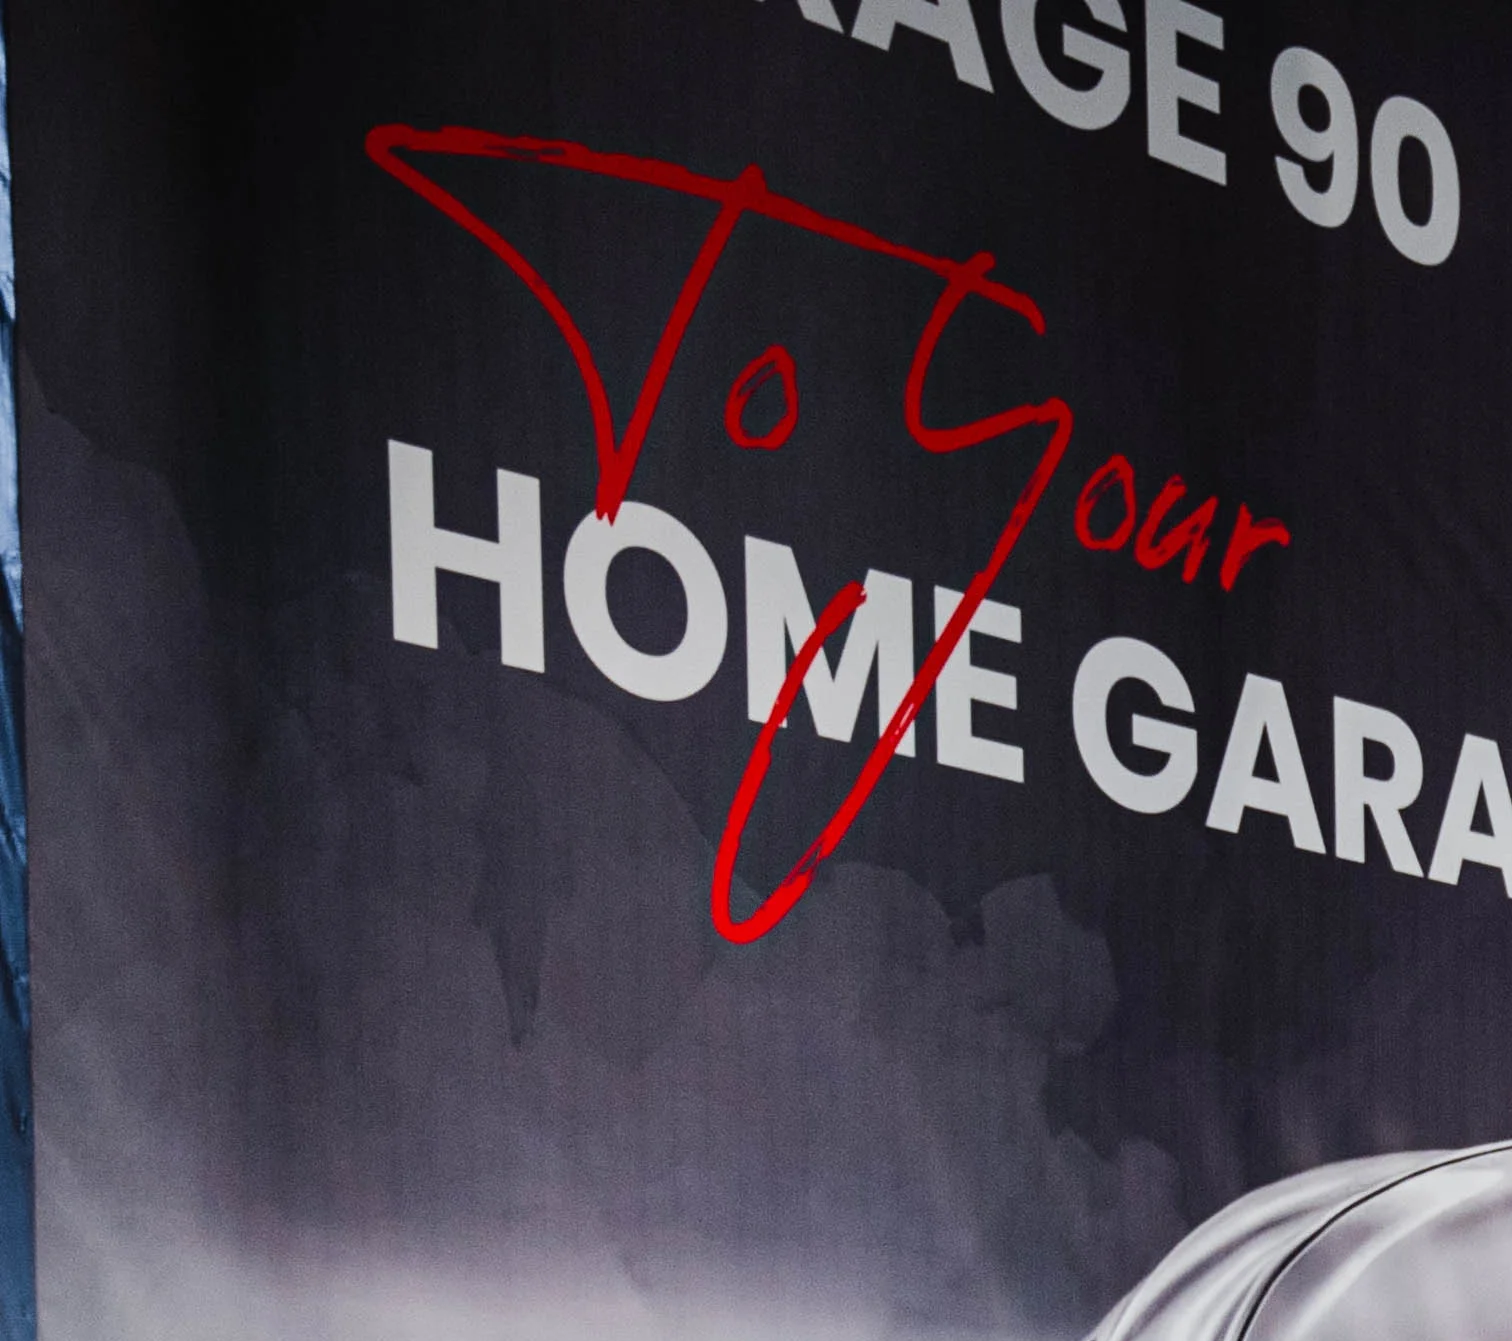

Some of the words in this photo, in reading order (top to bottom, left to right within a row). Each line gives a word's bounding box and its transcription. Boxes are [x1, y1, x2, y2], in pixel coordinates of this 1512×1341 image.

[758, 0, 1227, 187] GE
[1270, 45, 1461, 266] 90
[365, 122, 850, 524] To
[388, 438, 1024, 783] HOME
